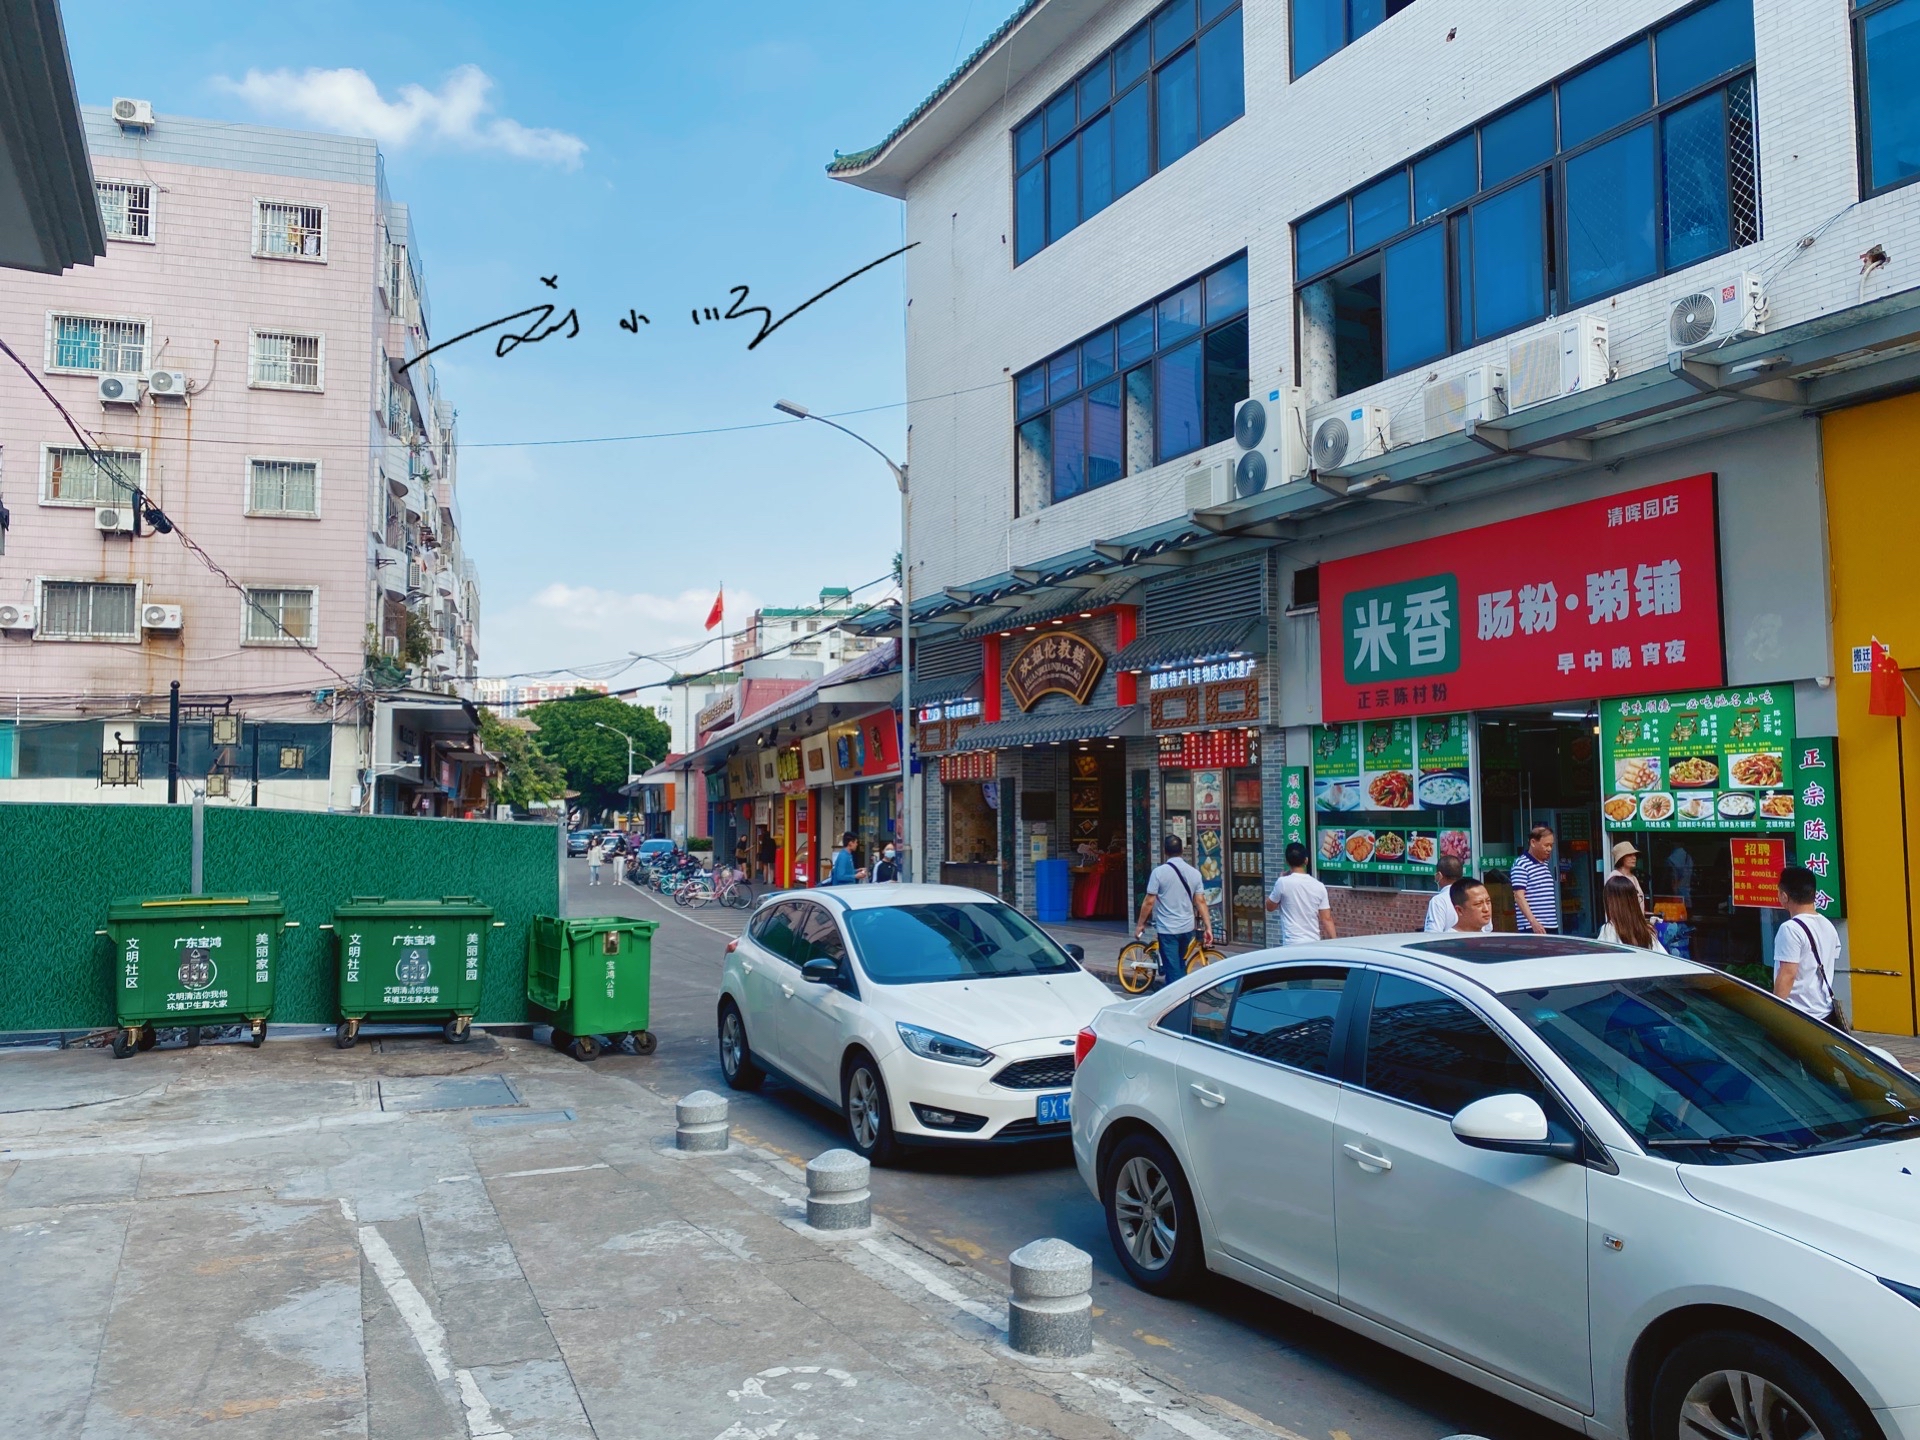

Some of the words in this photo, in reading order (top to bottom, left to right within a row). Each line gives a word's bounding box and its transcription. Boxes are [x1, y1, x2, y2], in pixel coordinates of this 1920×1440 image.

[1607, 495, 1679, 528] 清晖园店
[1353, 586, 1451, 672] 米香
[1853, 663, 1872, 672] 13760
[1357, 683, 1448, 710] 正宗陈村粉
[1763, 714, 1772, 733] 正宗
[1745, 843, 1770, 856] 招聘
[174, 936, 222, 949] 广东宝鸿
[392, 935, 436, 946] 广东宝鸿
[125, 938, 139, 989] 文明社区
[256, 933, 269, 983] 美丽家园
[347, 934, 361, 982] 文明社区
[465, 933, 478, 981] 美丽家园
[606, 960, 615, 999] 宝鸿公司
[167, 989, 228, 1001] 文明清洁你我他
[383, 986, 439, 995] 文明清洁你我他
[383, 995, 439, 1004] 环境卫生靠大家
[167, 999, 228, 1011] 环境卫生靠大家
